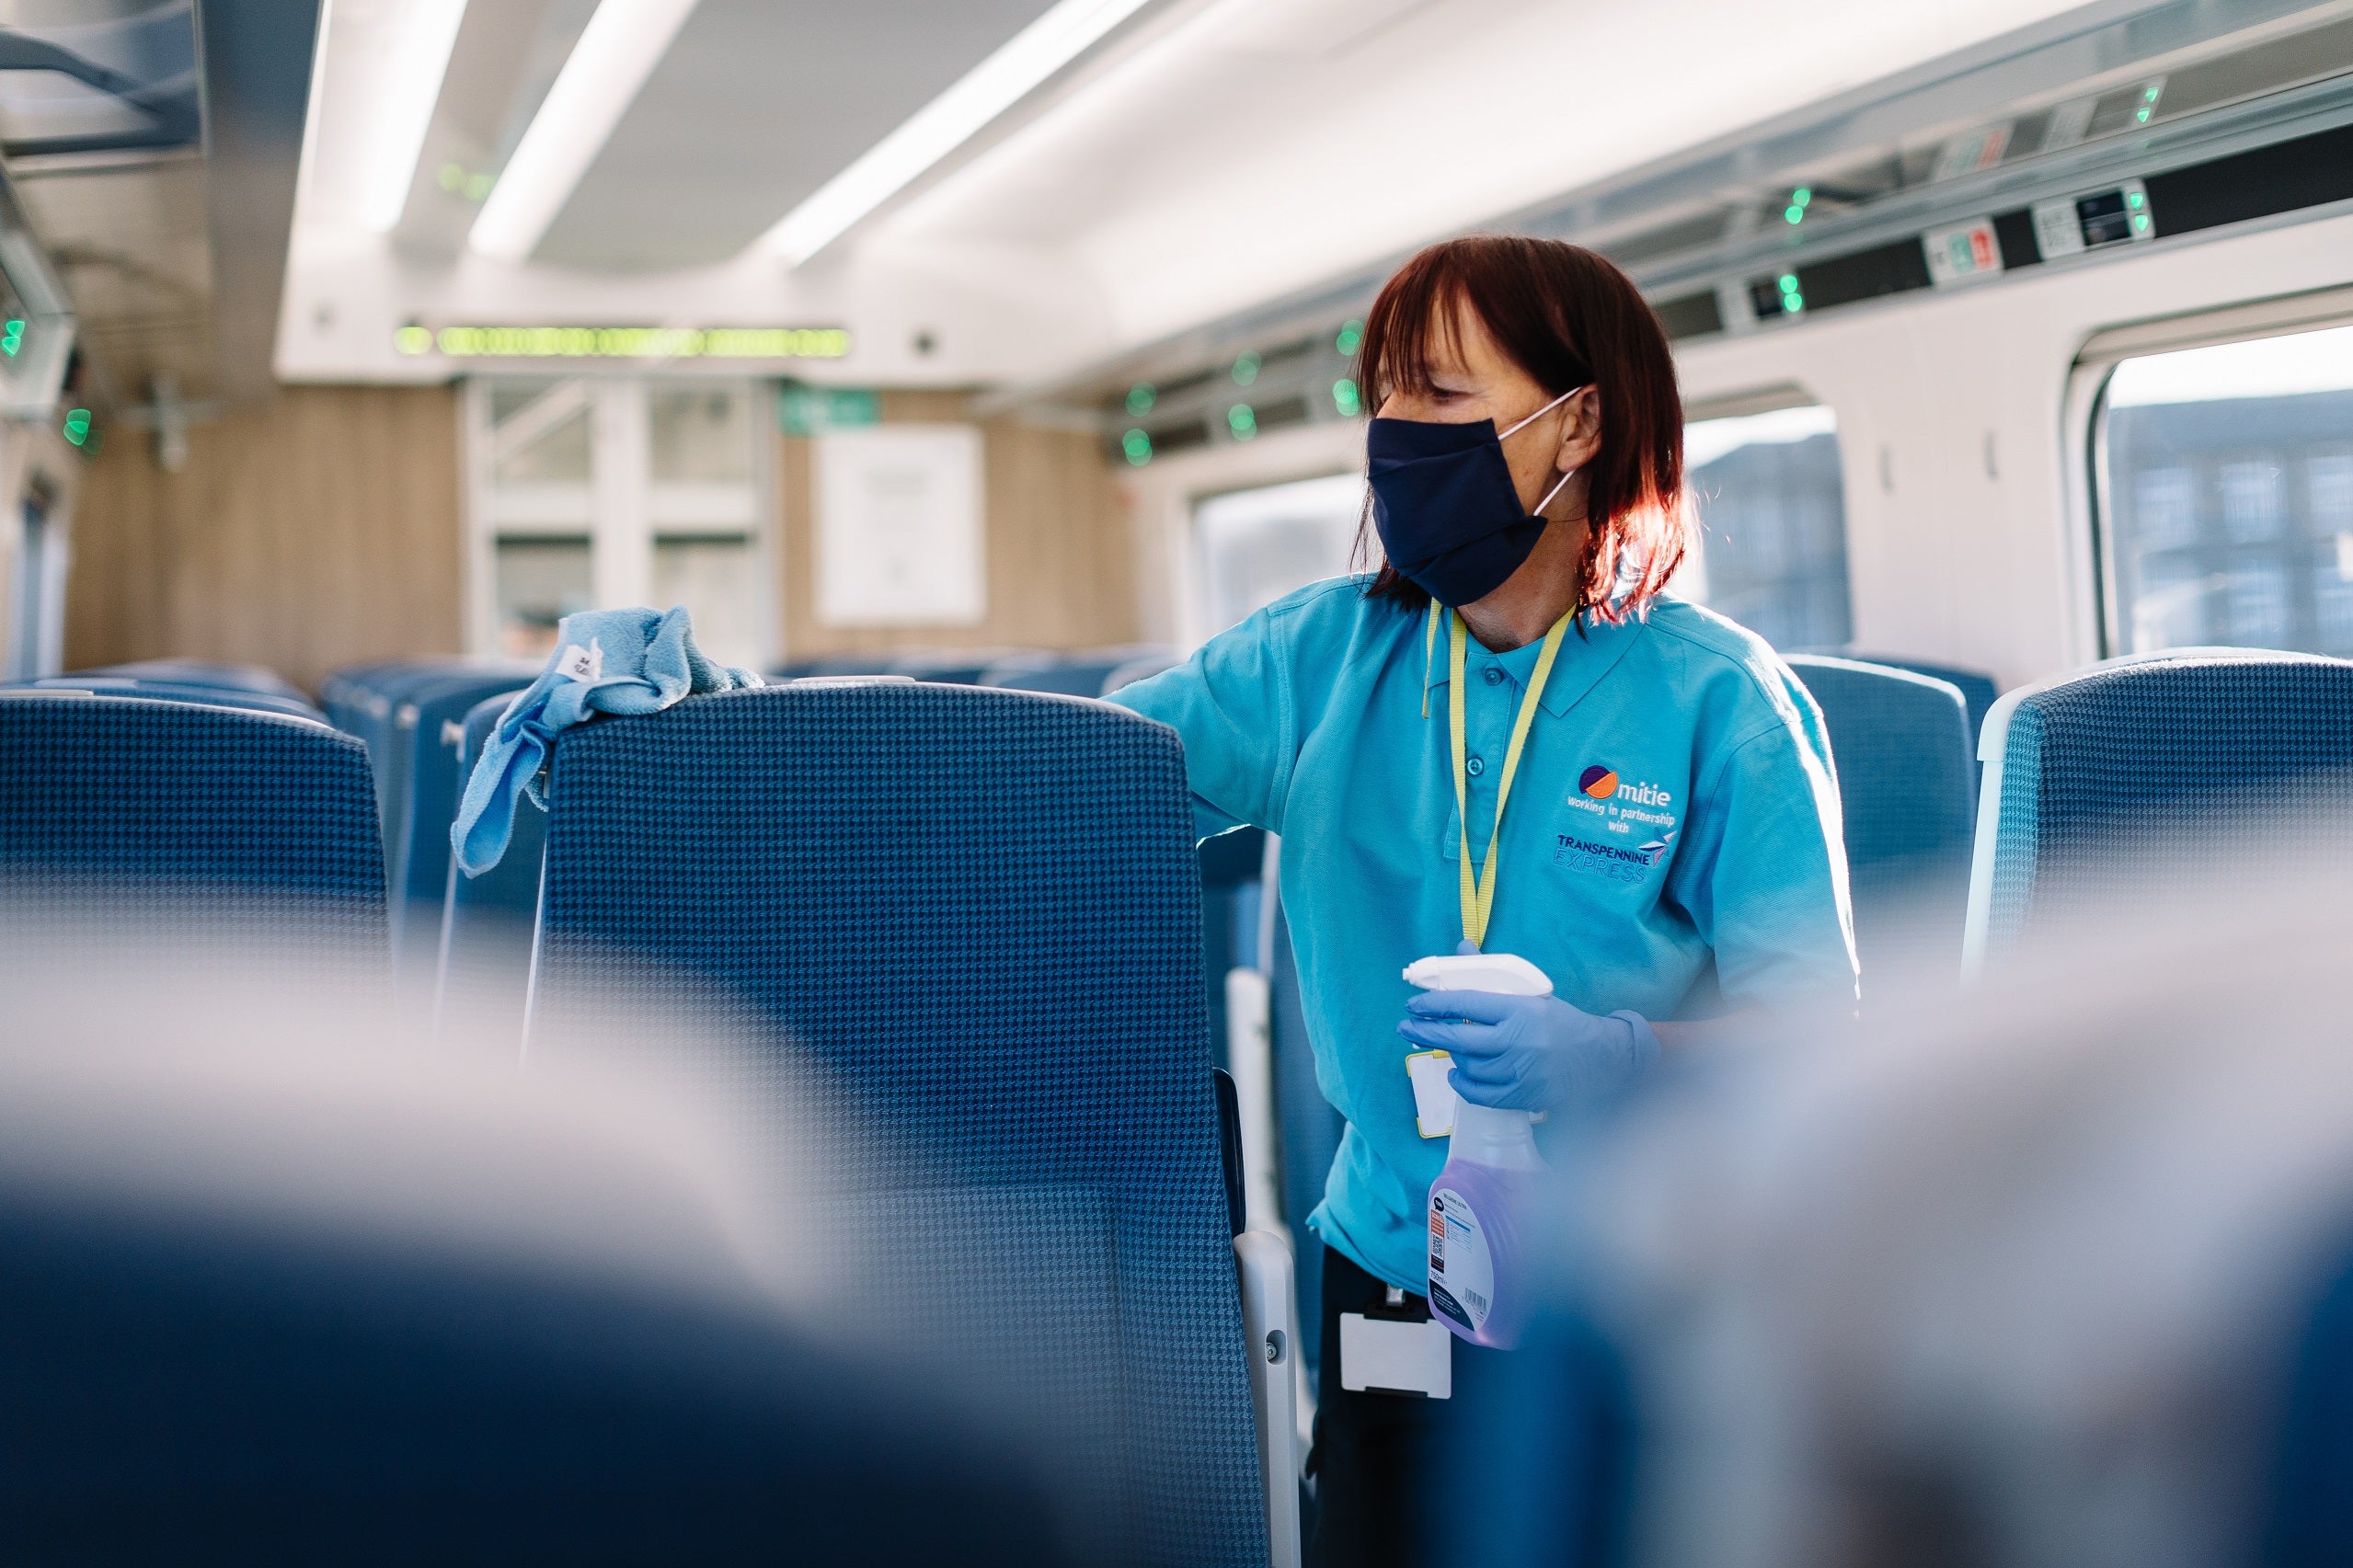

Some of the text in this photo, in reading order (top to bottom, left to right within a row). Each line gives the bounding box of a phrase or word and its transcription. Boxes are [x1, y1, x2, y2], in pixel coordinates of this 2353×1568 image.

[1617, 782, 1671, 807] mitie
[1608, 803, 1618, 816] in
[1621, 807, 1675, 828] partnership
[1608, 820, 1630, 833] with
[1557, 834, 1650, 865] TRANSPENNINE
[1554, 847, 1647, 884] EXPRESS
